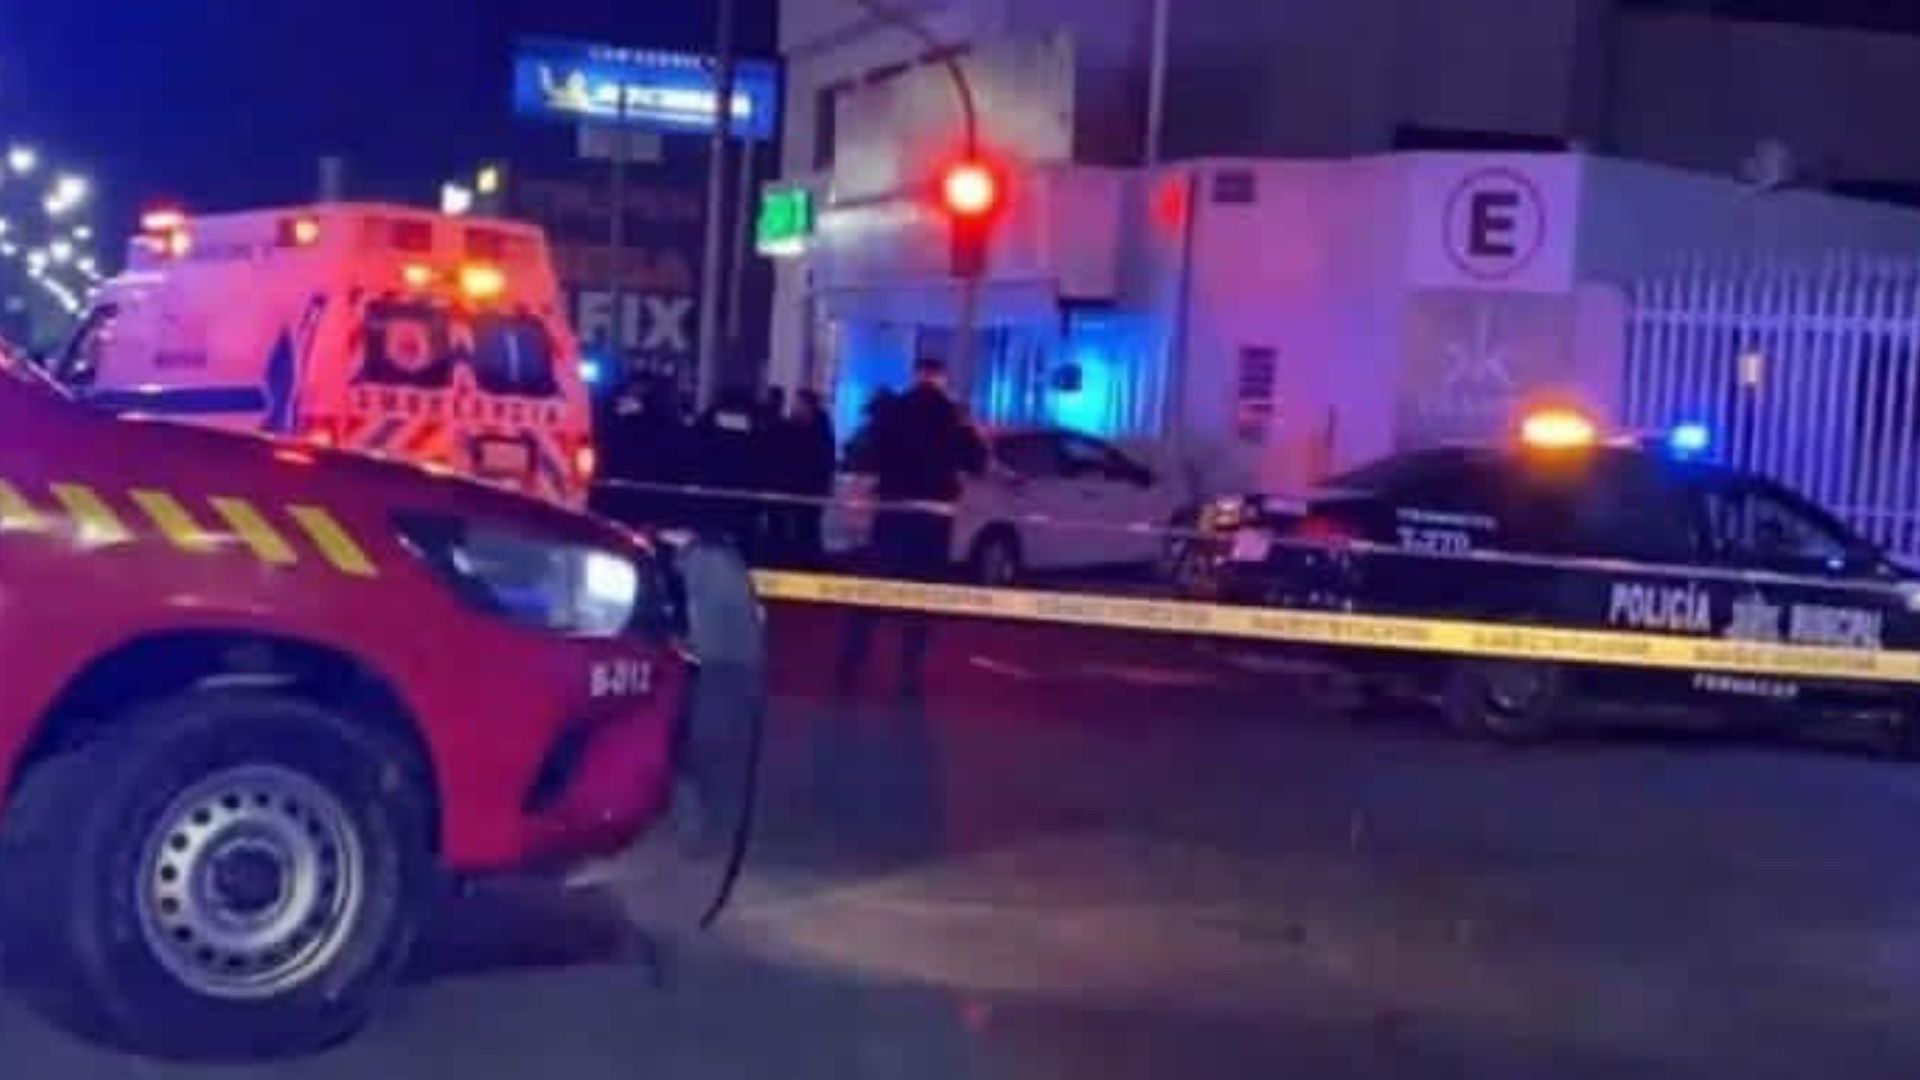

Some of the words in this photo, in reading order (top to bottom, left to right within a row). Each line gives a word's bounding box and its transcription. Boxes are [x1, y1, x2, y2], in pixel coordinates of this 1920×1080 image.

[1467, 191, 1520, 256] E
[578, 291, 696, 350] FIX
[1608, 581, 1711, 633] POLICÍA
